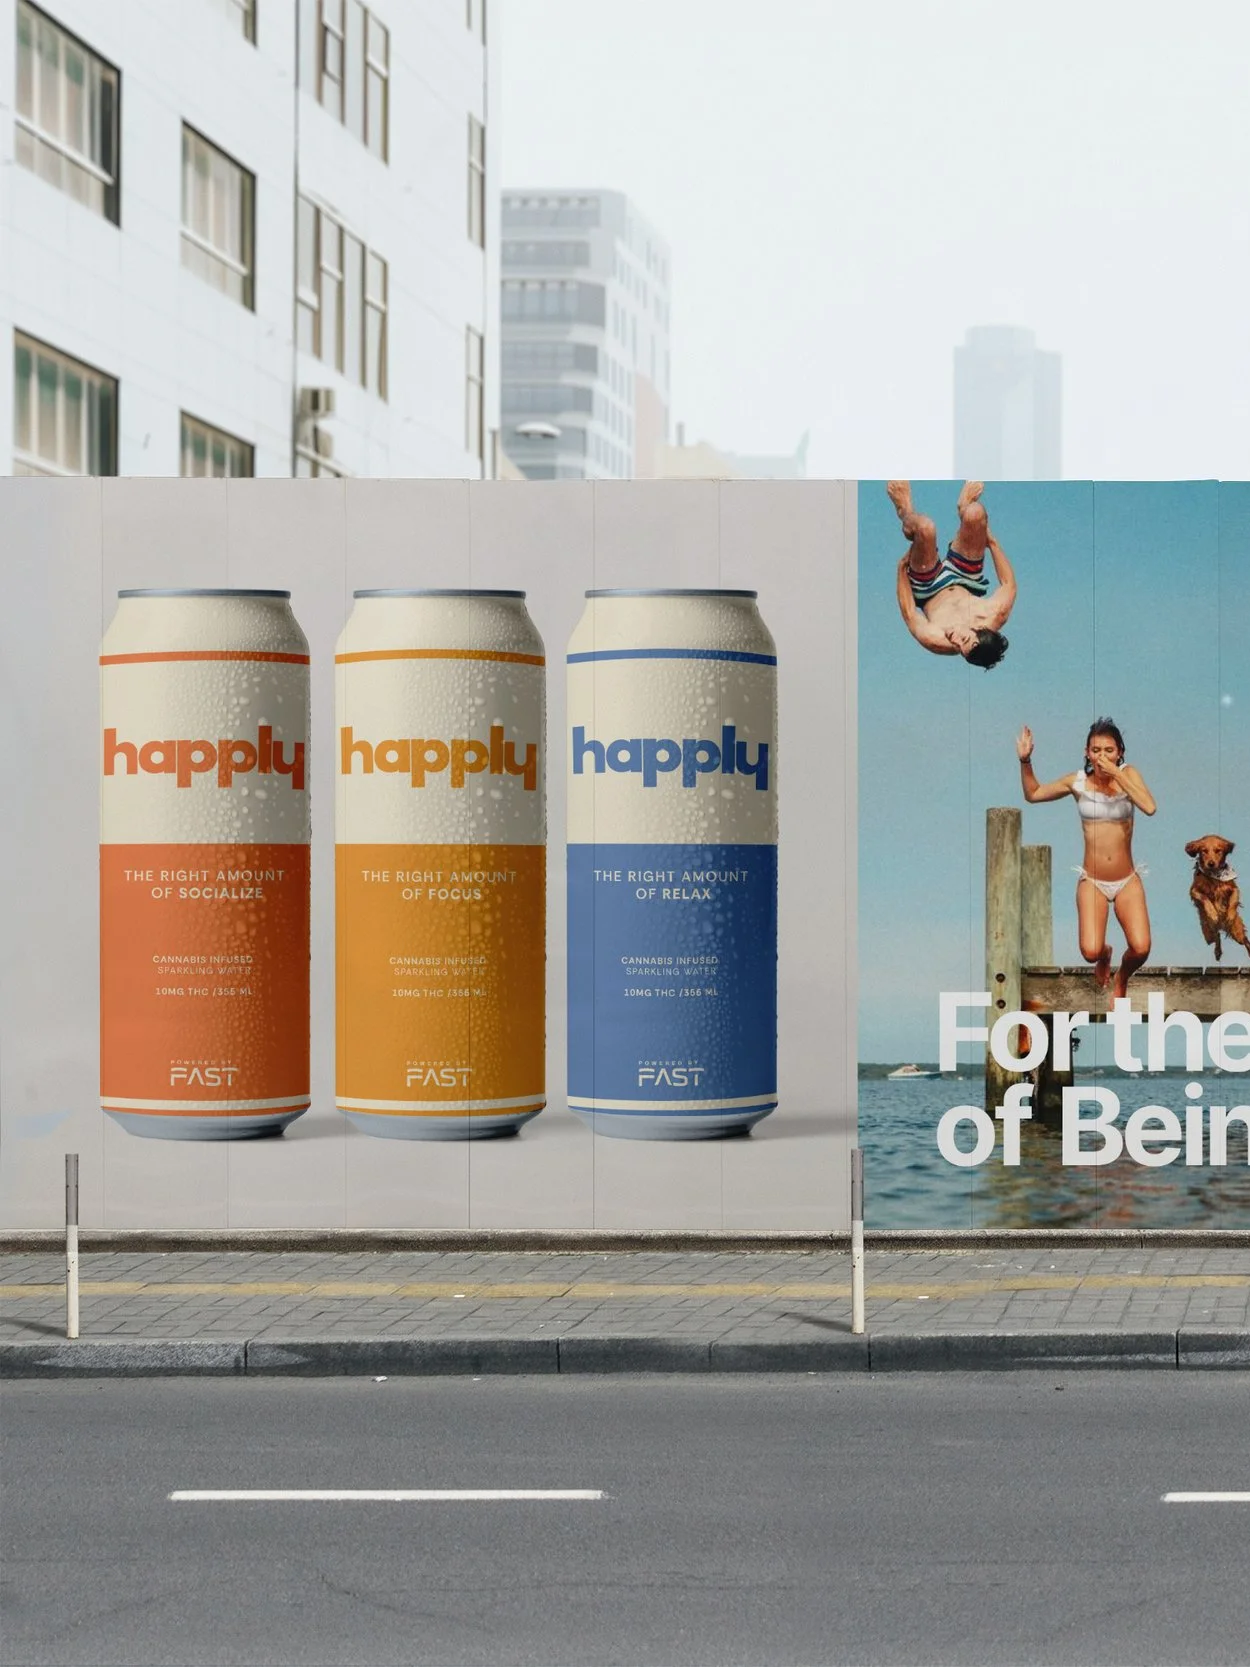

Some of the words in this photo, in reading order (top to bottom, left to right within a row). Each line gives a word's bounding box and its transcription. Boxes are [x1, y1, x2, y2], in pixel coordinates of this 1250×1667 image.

[103, 725, 305, 790] happly
[341, 725, 537, 791] happly
[572, 725, 769, 791] happly
[124, 870, 153, 881] THE
[160, 870, 209, 881] RIGHT
[216, 870, 285, 881] AMOUNT
[361, 870, 390, 882] THE
[396, 870, 444, 882] RIGHT
[450, 871, 517, 883] AMOUNT
[594, 870, 622, 882] THE
[628, 870, 675, 882] RIGHT
[681, 870, 748, 882] AMOUNT
[151, 887, 173, 899] OF
[179, 887, 263, 899] SOCIALIZE
[402, 888, 423, 900] OF
[428, 888, 482, 900] FOCUS
[635, 888, 657, 900] OF
[662, 888, 711, 900] RELAX
[152, 955, 206, 964] CANNABIS
[209, 955, 253, 964] INFUSED
[389, 956, 441, 965] CANNABIS
[621, 956, 673, 965] CANNABIS
[676, 956, 718, 965] INFUSED
[157, 966, 213, 975] SPARKLING
[394, 967, 448, 976] SPARKLING
[626, 967, 680, 976] SPARKLING
[684, 967, 717, 976] WATER
[156, 987, 184, 996] 10MG
[188, 987, 208, 996] THC
[392, 988, 420, 997] 10MG
[423, 988, 443, 997] THC
[624, 988, 652, 997] 10MG
[655, 988, 675, 997] THC
[938, 992, 1089, 1072] For
[170, 1067, 239, 1086] FAST
[406, 1068, 472, 1087] FAST
[638, 1067, 704, 1087] FAST
[936, 1082, 1035, 1167] of
